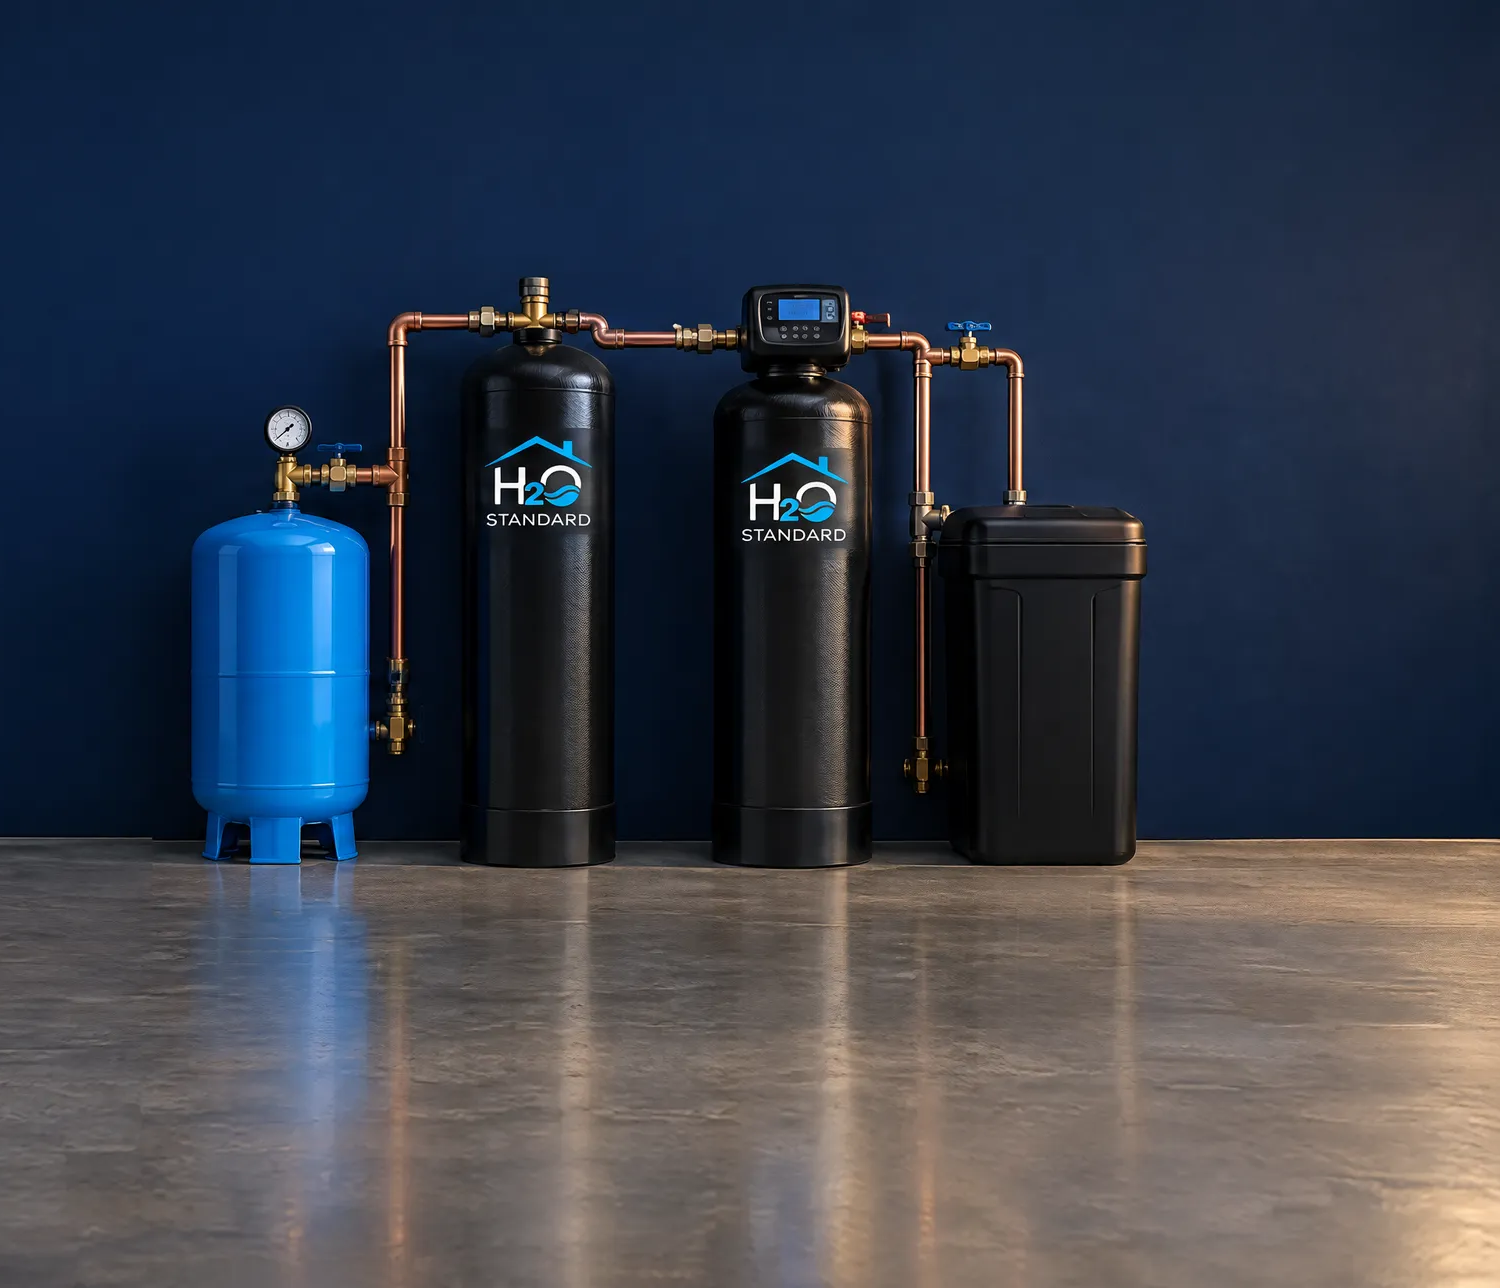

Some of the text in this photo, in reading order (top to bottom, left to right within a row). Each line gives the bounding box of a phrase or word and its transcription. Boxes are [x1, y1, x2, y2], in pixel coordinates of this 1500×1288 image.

[494, 465, 582, 507] H2O
[749, 481, 837, 523] H2O
[486, 512, 591, 527] STANDARD
[741, 528, 847, 542] STANDARD
